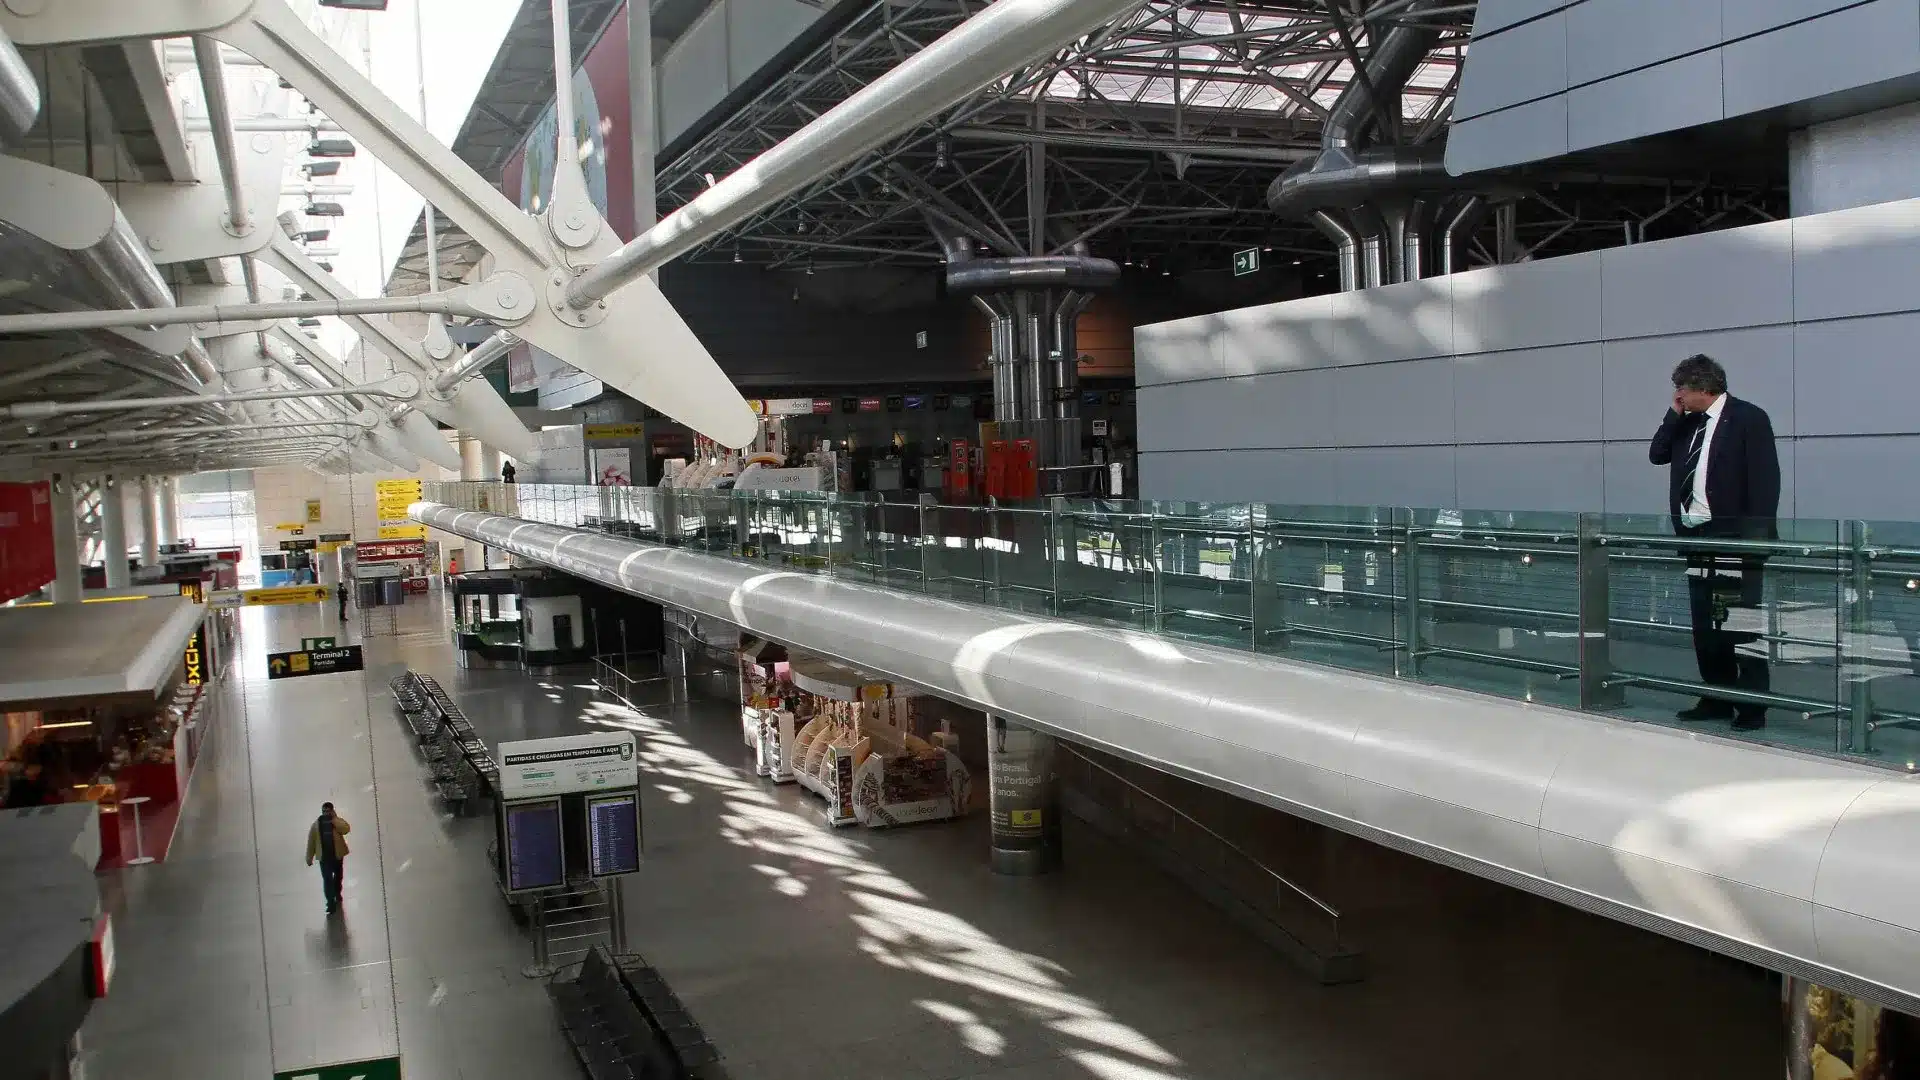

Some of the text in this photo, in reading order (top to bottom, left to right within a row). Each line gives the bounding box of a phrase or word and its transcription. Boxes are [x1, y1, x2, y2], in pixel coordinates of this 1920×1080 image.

[312, 649, 351, 660] Terminal 2
[1004, 775, 1041, 787] Portugal
[997, 789, 1019, 797] anos.
